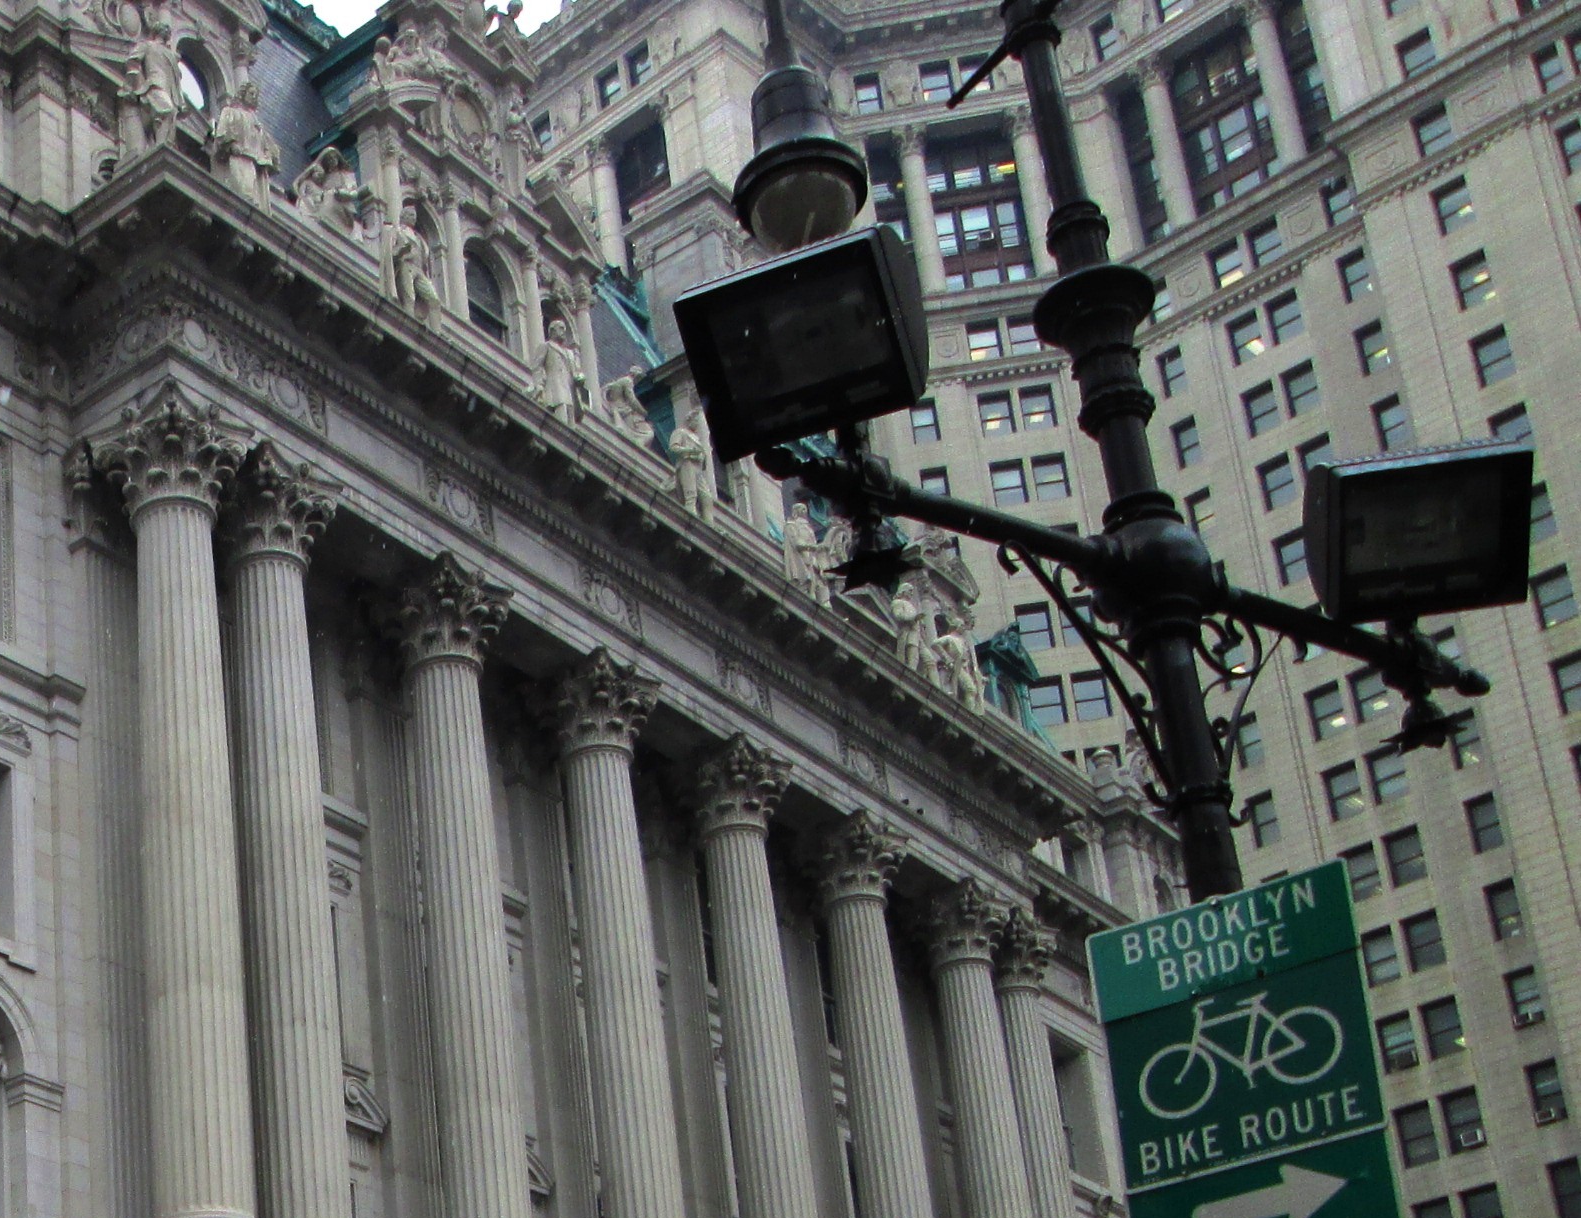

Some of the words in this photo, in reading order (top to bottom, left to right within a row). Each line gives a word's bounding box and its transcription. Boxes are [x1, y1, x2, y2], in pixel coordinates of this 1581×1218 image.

[1121, 878, 1316, 965] BROOKLYN
[1157, 923, 1290, 991] BRIDGE
[1139, 1125, 1224, 1176] BIKE
[1239, 1084, 1365, 1149] ROUTE
